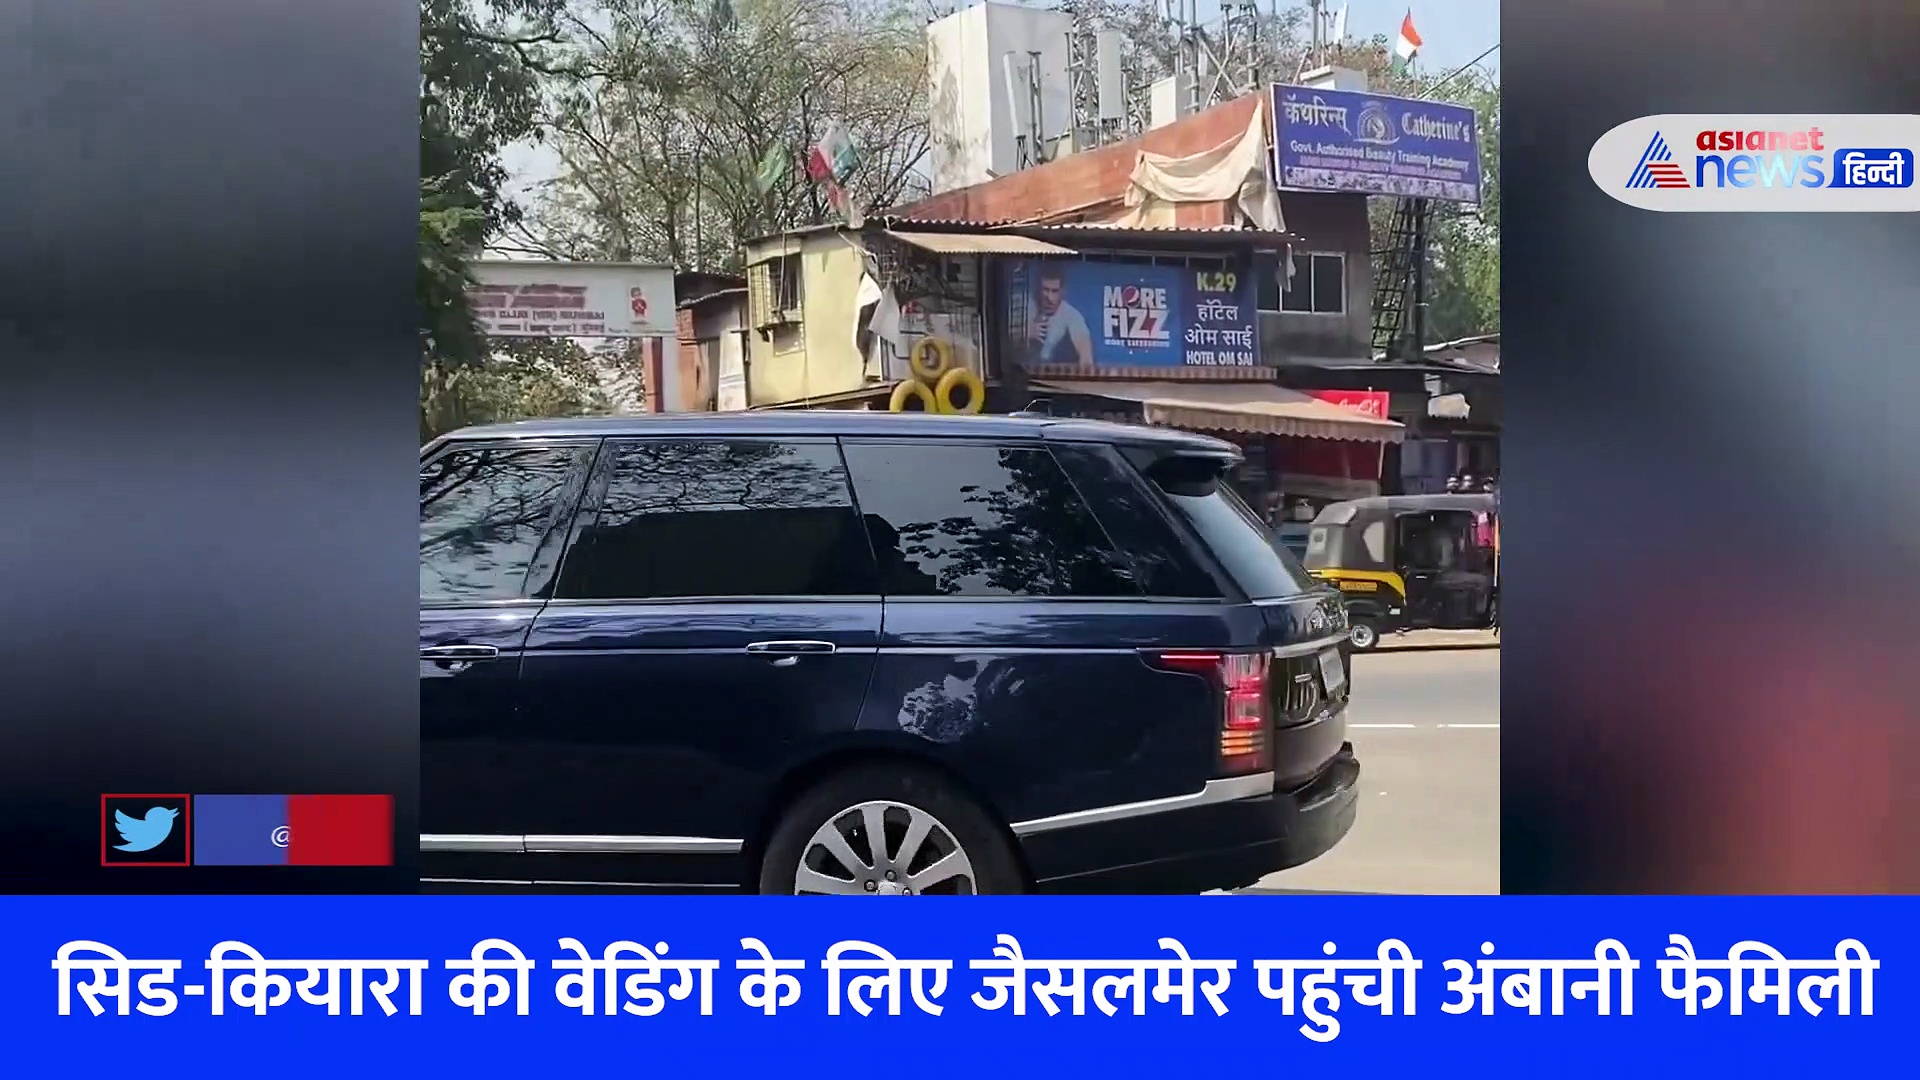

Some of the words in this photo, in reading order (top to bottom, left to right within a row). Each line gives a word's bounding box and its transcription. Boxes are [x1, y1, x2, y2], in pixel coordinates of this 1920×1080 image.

[1401, 112, 1470, 143] Catherine's
[1290, 140, 1313, 154] Govt.
[1397, 150, 1431, 168] Training
[1432, 156, 1469, 173] Academy
[1196, 272, 1237, 293] K.29
[1104, 285, 1167, 309] MORE
[1104, 309, 1170, 339] FIZZ
[1184, 323, 1218, 346] ओम
[1222, 325, 1253, 350] साई
[1186, 350, 1216, 365] HOTEL
[1218, 351, 1236, 366] OM
[1237, 352, 1253, 366] SAI
